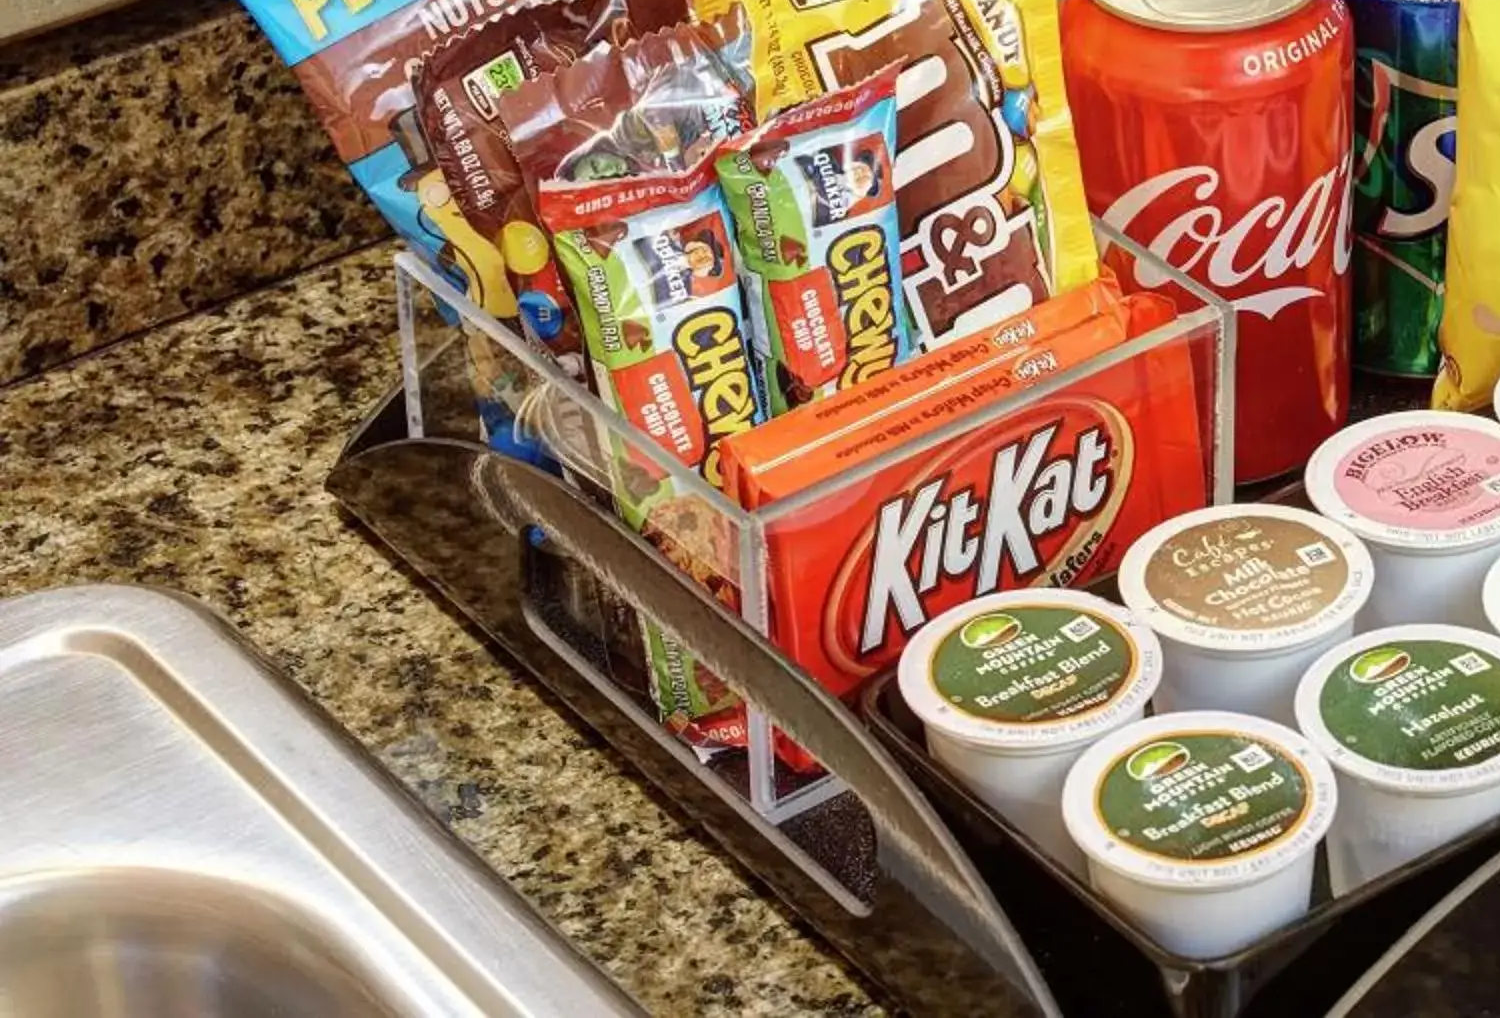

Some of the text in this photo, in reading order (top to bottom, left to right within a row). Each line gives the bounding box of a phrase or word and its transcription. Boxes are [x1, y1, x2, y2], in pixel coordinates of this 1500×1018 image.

[1243, 16, 1340, 76] ORIGINAL
[430, 87, 453, 112] NET
[439, 109, 462, 133] WT
[459, 152, 481, 174] OZ
[813, 152, 849, 221] QUAKER
[1100, 152, 1354, 287] Coca
[653, 231, 689, 302] QUAKER
[789, 317, 815, 354] CHIP
[799, 287, 837, 371] CHOCOLATE
[899, 359, 952, 385] Wafers
[953, 343, 990, 364] Crisp
[975, 374, 1013, 398] Crisp
[640, 402, 667, 440] CHIP
[648, 371, 694, 457] CHOCOLATE
[922, 393, 976, 421] Wafers
[1344, 432, 1446, 483] BIGELOW
[1392, 464, 1466, 501] English
[1398, 470, 1485, 513] Breakfast
[1204, 564, 1312, 607] Chocolate
[1222, 556, 1269, 589] Milk
[1231, 600, 1266, 622] Hot
[1266, 586, 1325, 610] Cocoa
[975, 635, 1064, 676] MOUNTAIN
[983, 630, 1041, 660] GREEN
[973, 639, 1112, 709] Breakfast Blend
[1029, 674, 1079, 700] DECAF
[1366, 667, 1455, 716] MOUNTAIN
[1374, 665, 1430, 698] GREEN
[1400, 693, 1486, 739] Hazelnut
[1143, 762, 1235, 813] MOUNTAIN
[1151, 762, 1210, 795] GREEN
[1142, 771, 1285, 842] Breakfast Blend
[1228, 823, 1283, 852] KEURIG
